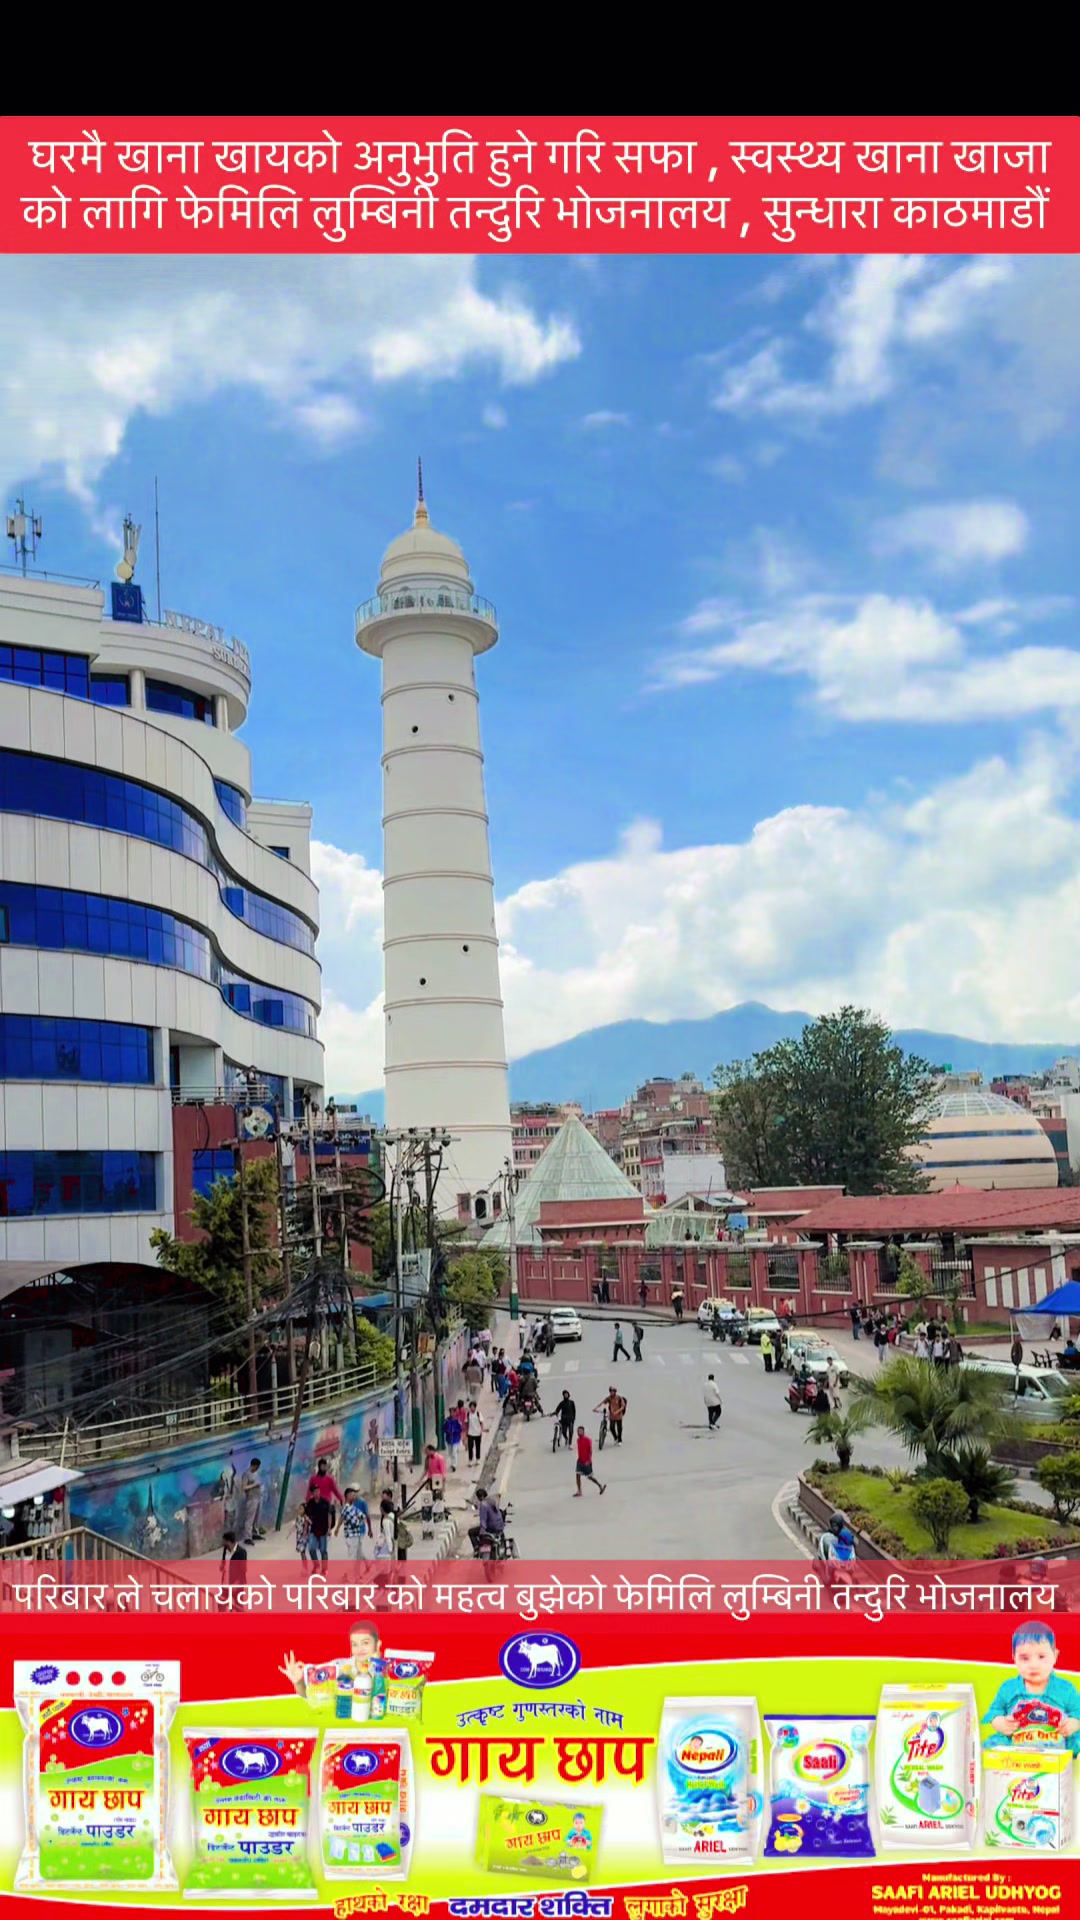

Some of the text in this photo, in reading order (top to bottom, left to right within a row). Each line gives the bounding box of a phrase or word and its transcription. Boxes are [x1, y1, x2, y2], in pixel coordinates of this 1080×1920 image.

[681, 1748, 725, 1764] Nepali
[908, 1739, 938, 1762] Tite
[48, 1790, 145, 1810] गाय छाप
[328, 1801, 392, 1815] गाय छाप
[203, 1809, 299, 1826] गाय छाप
[86, 1825, 136, 1838] पाउडर
[352, 1823, 385, 1832] पाउडर
[505, 1829, 561, 1849] गाय छाप
[694, 1840, 727, 1853] ARIEL
[237, 1841, 295, 1855] पाउडर
